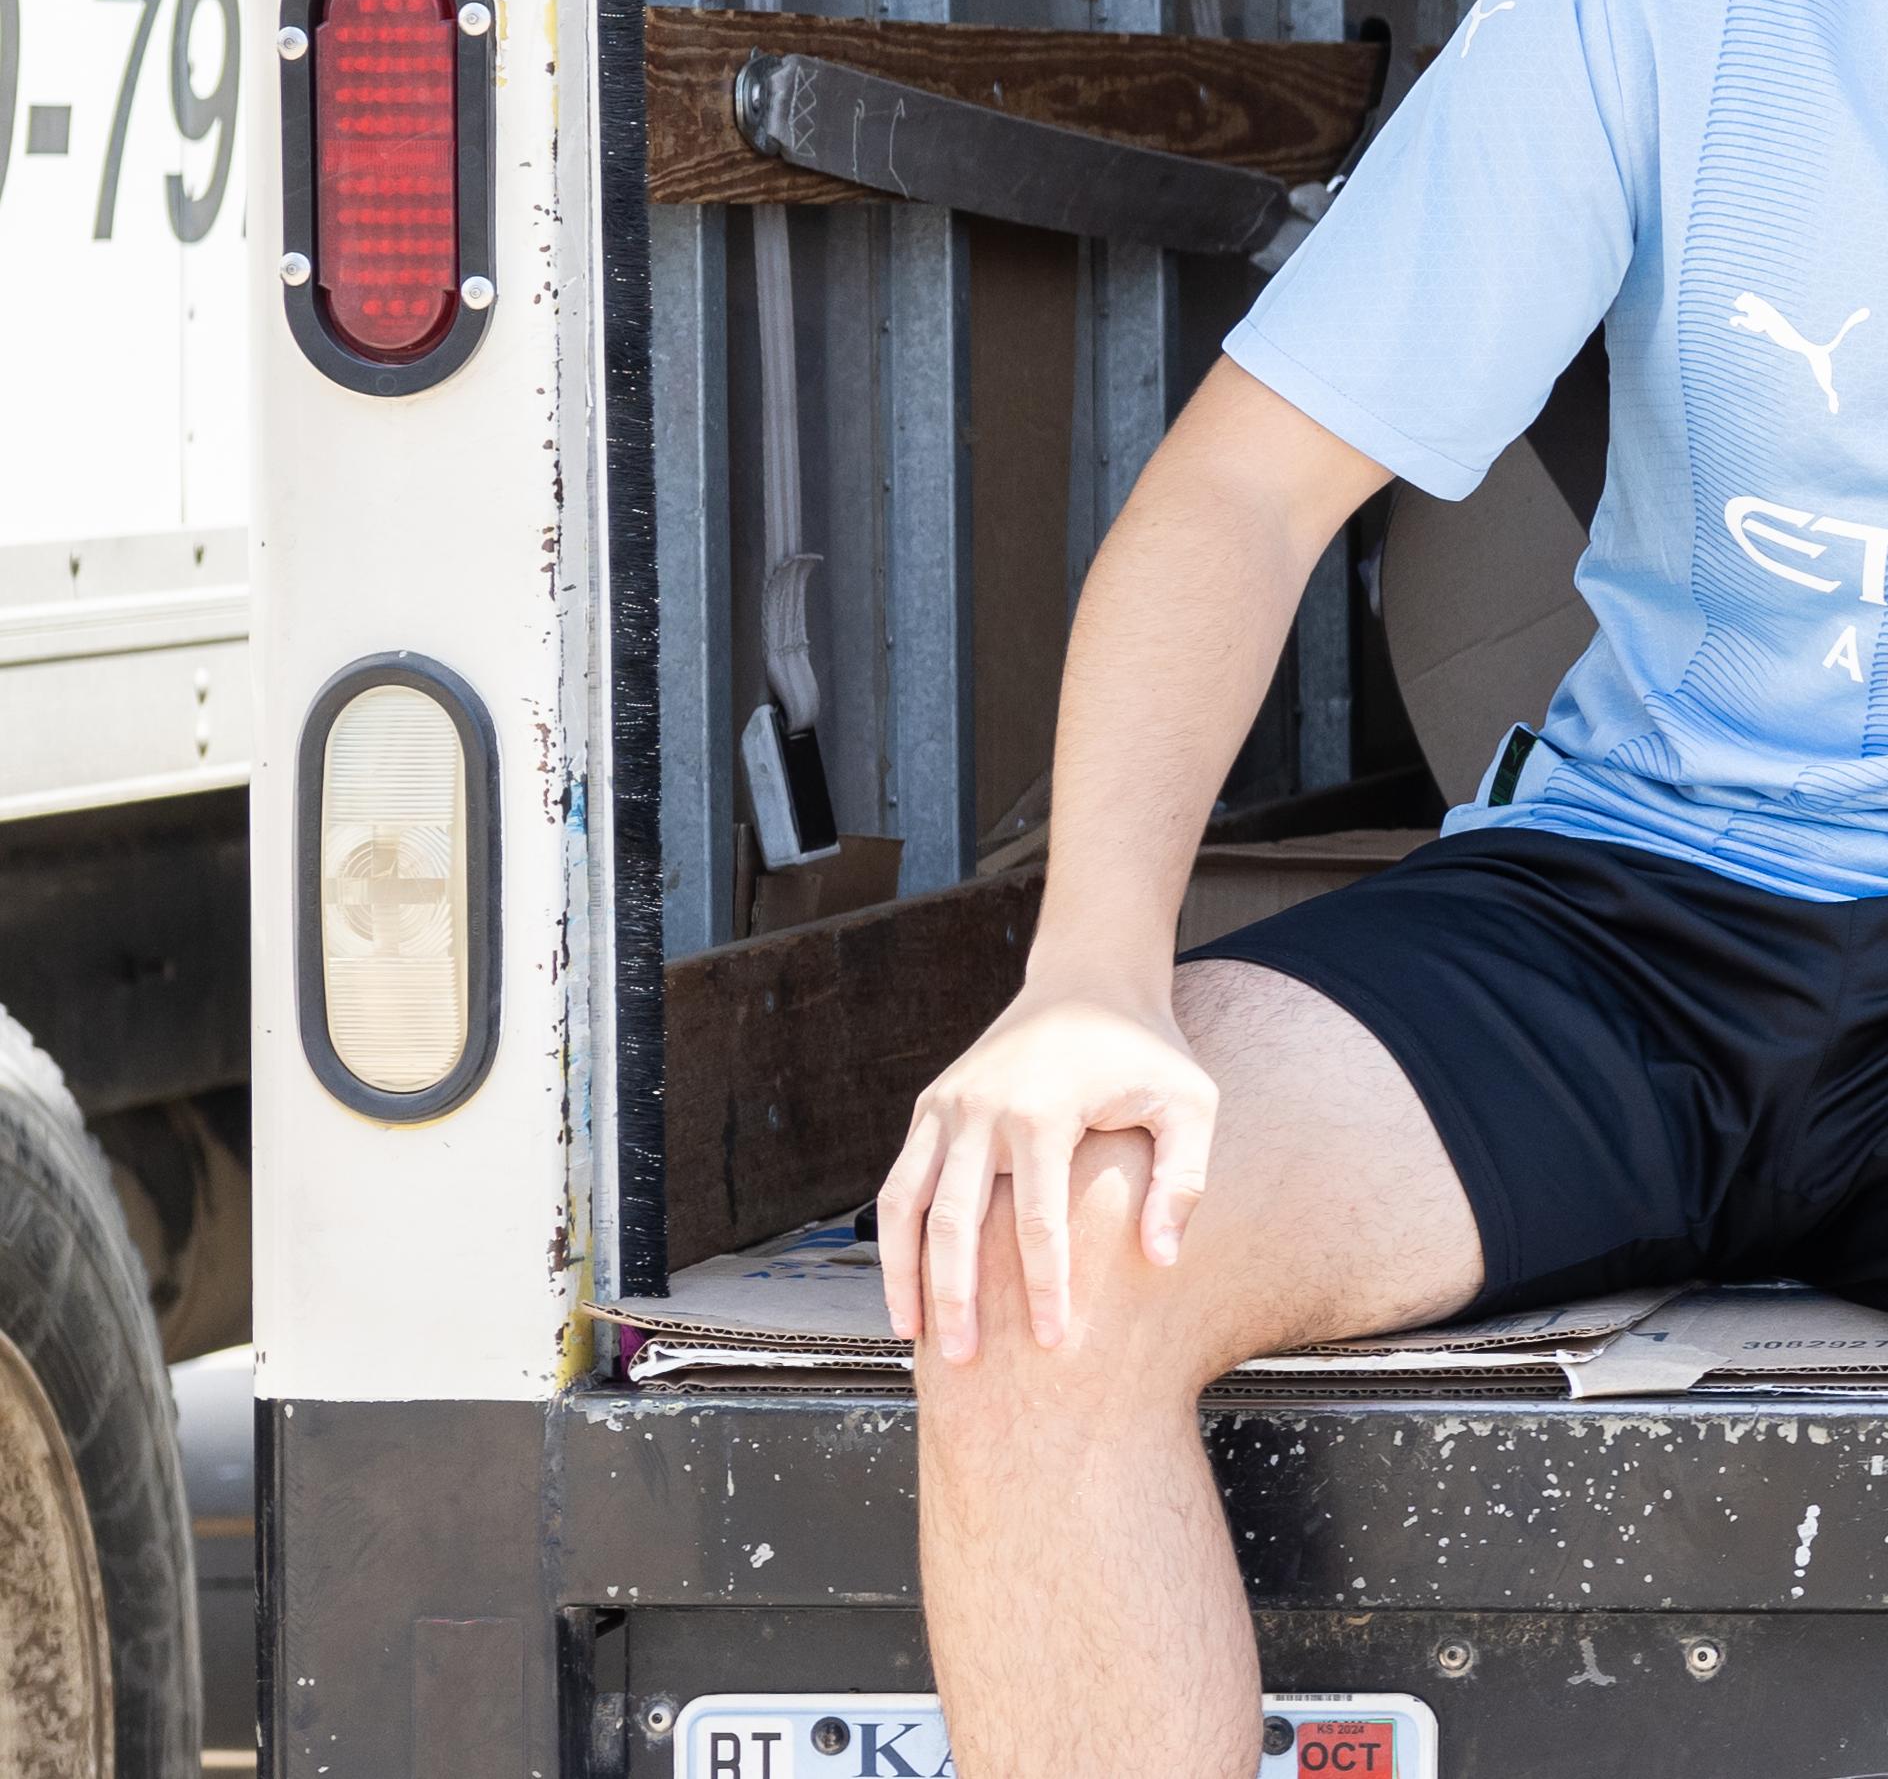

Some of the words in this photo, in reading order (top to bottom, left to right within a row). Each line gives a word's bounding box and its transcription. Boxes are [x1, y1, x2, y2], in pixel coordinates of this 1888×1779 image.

[1316, 1724, 1334, 1735] KS
[1337, 1723, 1365, 1735] 2024
[710, 1731, 782, 1779] BT
[852, 1723, 955, 1778] K
[1301, 1741, 1382, 1772] OCT
